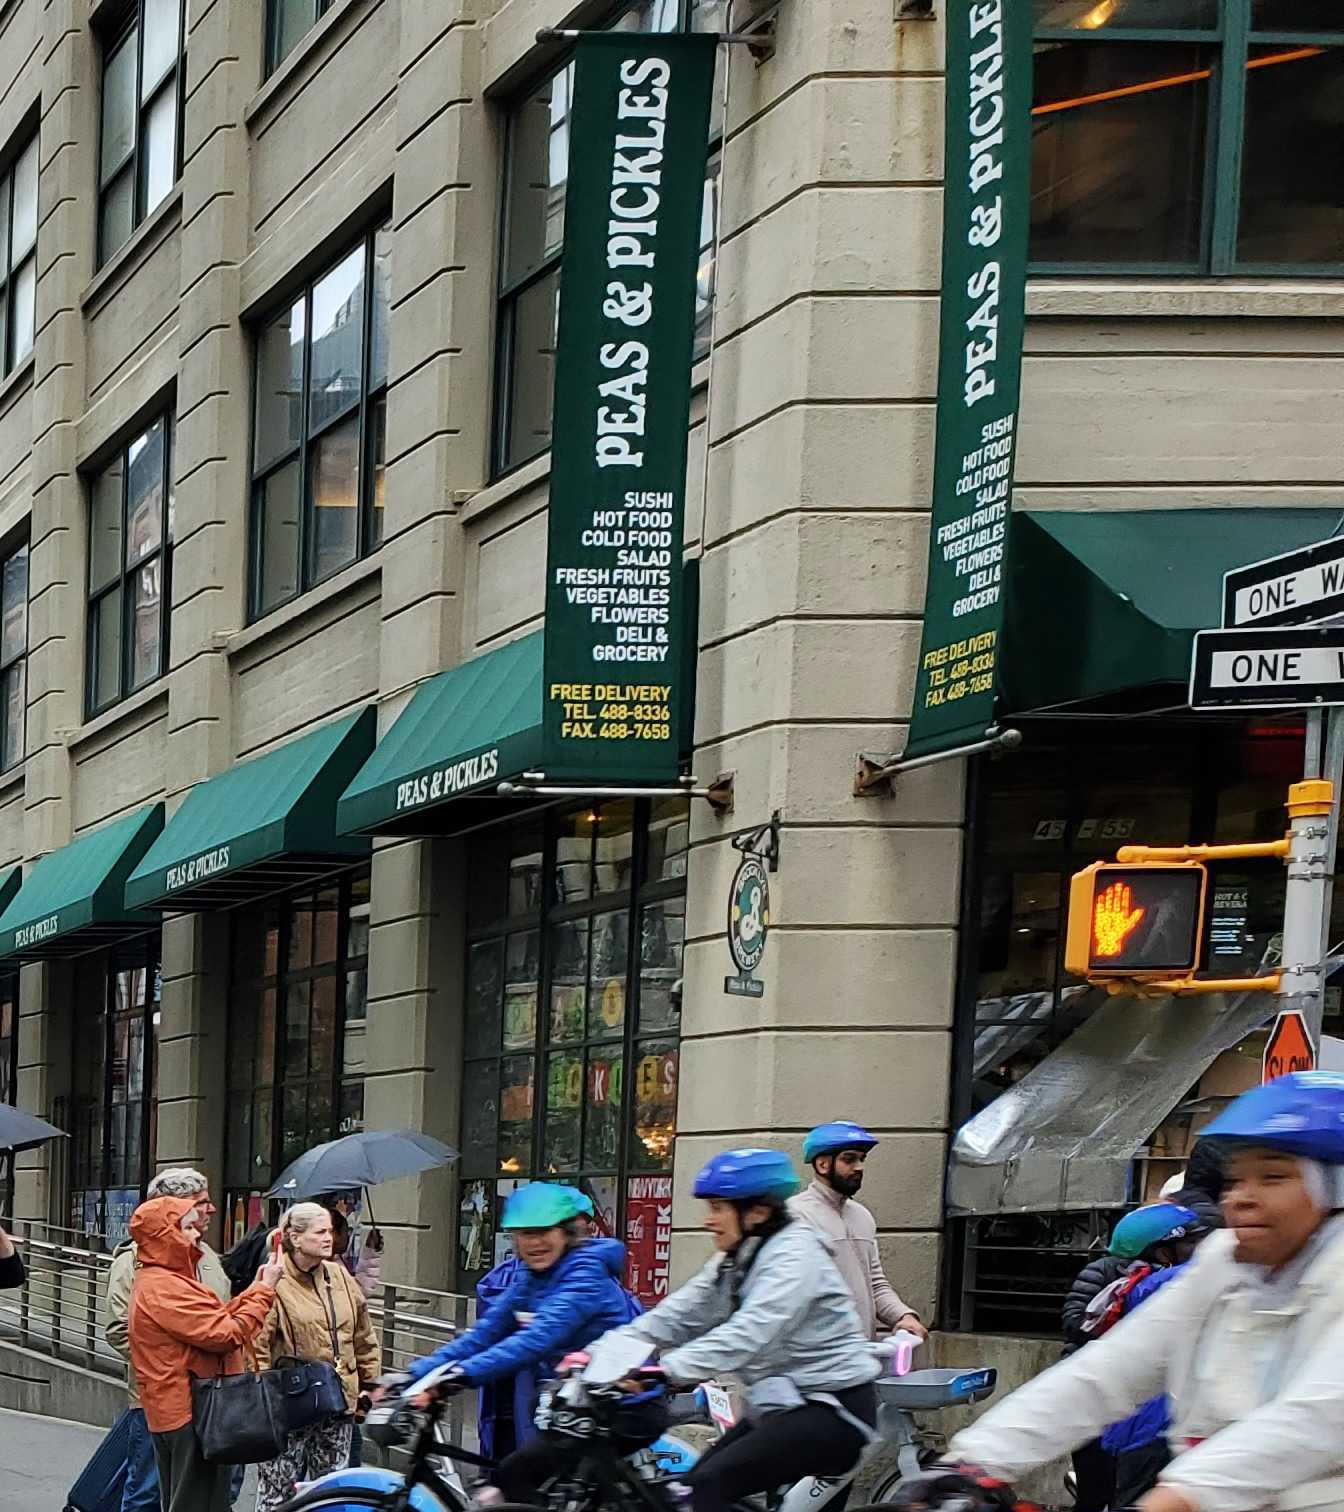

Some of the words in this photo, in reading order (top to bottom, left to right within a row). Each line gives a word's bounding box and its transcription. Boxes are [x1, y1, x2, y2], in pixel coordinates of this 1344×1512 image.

[968, 0, 1003, 193] PICKLE
[606, 56, 671, 269] PICKLES
[968, 196, 1002, 248] &
[603, 280, 653, 327] &
[964, 261, 1000, 408] PEAS
[595, 341, 650, 469] PEAS
[981, 413, 1014, 443] SUSHI
[963, 449, 983, 473] HOT
[983, 436, 1012, 461] FOOD
[956, 471, 982, 496] COLD
[981, 456, 1010, 485] FOOD
[624, 492, 673, 509] SUSHI
[976, 479, 1008, 508] SALAD
[593, 511, 626, 528] HOT
[629, 511, 672, 528] FOOD
[938, 514, 971, 544] FRESH
[971, 501, 1007, 530] FRUITS
[581, 530, 625, 547] COLD
[628, 530, 672, 547] FOOD
[944, 522, 1005, 561] VEGETABLES
[617, 550, 671, 567] SALAD
[955, 544, 1003, 576] FLOWERS
[556, 569, 610, 585] FRESH
[612, 569, 671, 586] FRUITS
[969, 569, 992, 593] DELI
[993, 565, 1001, 582] &
[566, 588, 670, 605] VEGETABLES
[953, 586, 1000, 617] GROCERY
[1249, 577, 1297, 616] ONE
[591, 607, 669, 624] FLOWERS
[616, 626, 653, 643] DELI
[656, 627, 669, 643] &
[924, 645, 949, 669] FREE
[949, 630, 998, 661] DELIVERY
[592, 645, 669, 662] GROCERY
[1232, 653, 1301, 682] ONE
[550, 684, 593, 700] FREE
[594, 685, 672, 702] DELIVERY
[563, 703, 597, 720] TEL.
[599, 704, 671, 721] 488-8336
[561, 722, 597, 738] FAX.
[599, 723, 670, 740] 488-7658
[396, 775, 429, 810] PEAS
[430, 771, 444, 799] &
[443, 749, 498, 794] PICKLES
[166, 864, 187, 891] PEAS
[187, 861, 195, 882] &
[195, 846, 230, 879] PICKLES
[654, 1203, 672, 1296] SLEEK
